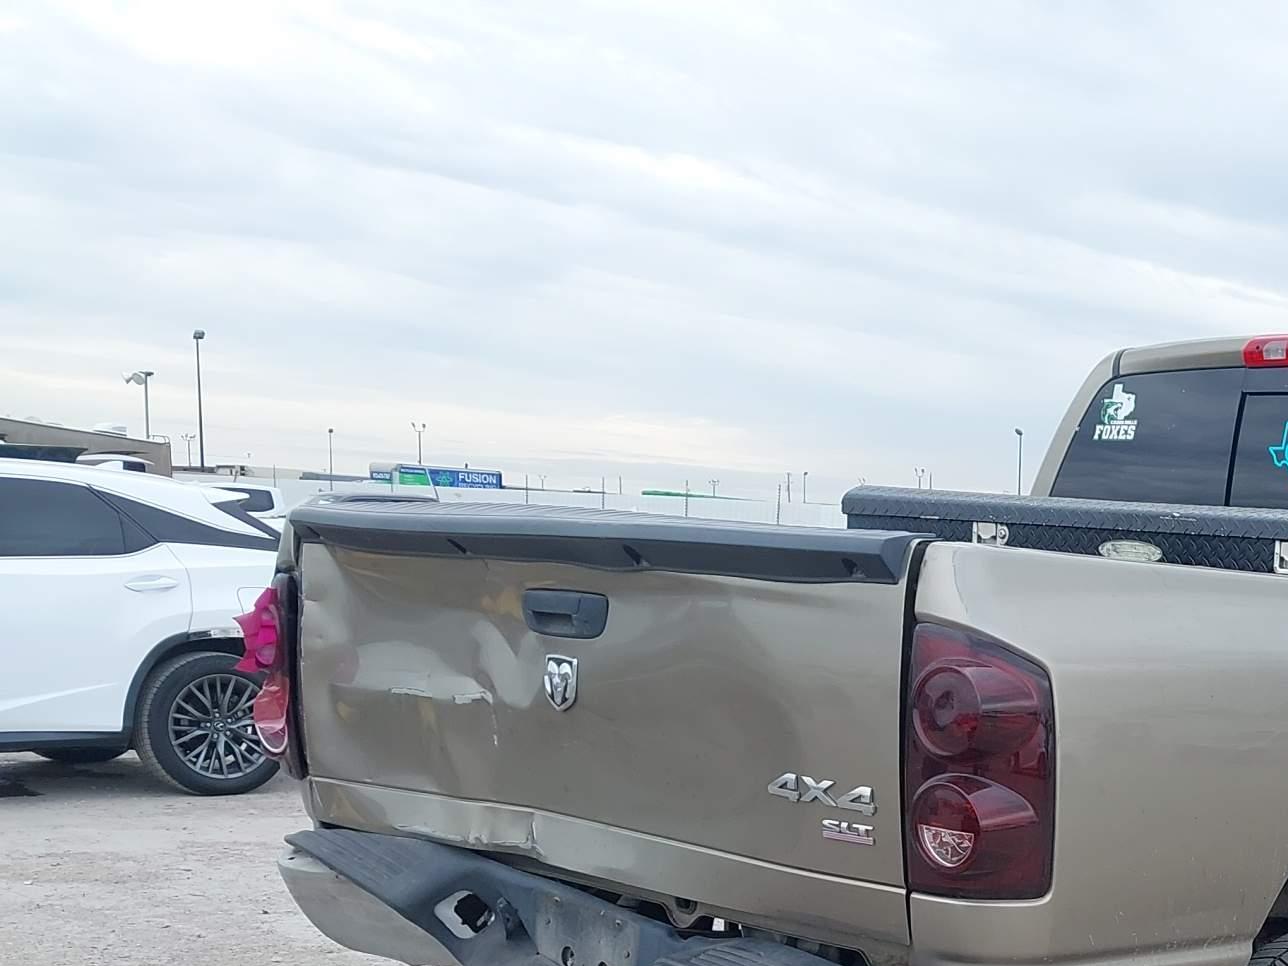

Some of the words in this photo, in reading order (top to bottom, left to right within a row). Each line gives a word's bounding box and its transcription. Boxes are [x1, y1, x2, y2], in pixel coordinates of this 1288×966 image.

[1093, 424, 1136, 440] FOXES
[458, 472, 497, 484] FUSION
[767, 772, 878, 817] 4X4
[821, 819, 875, 838] SLT
